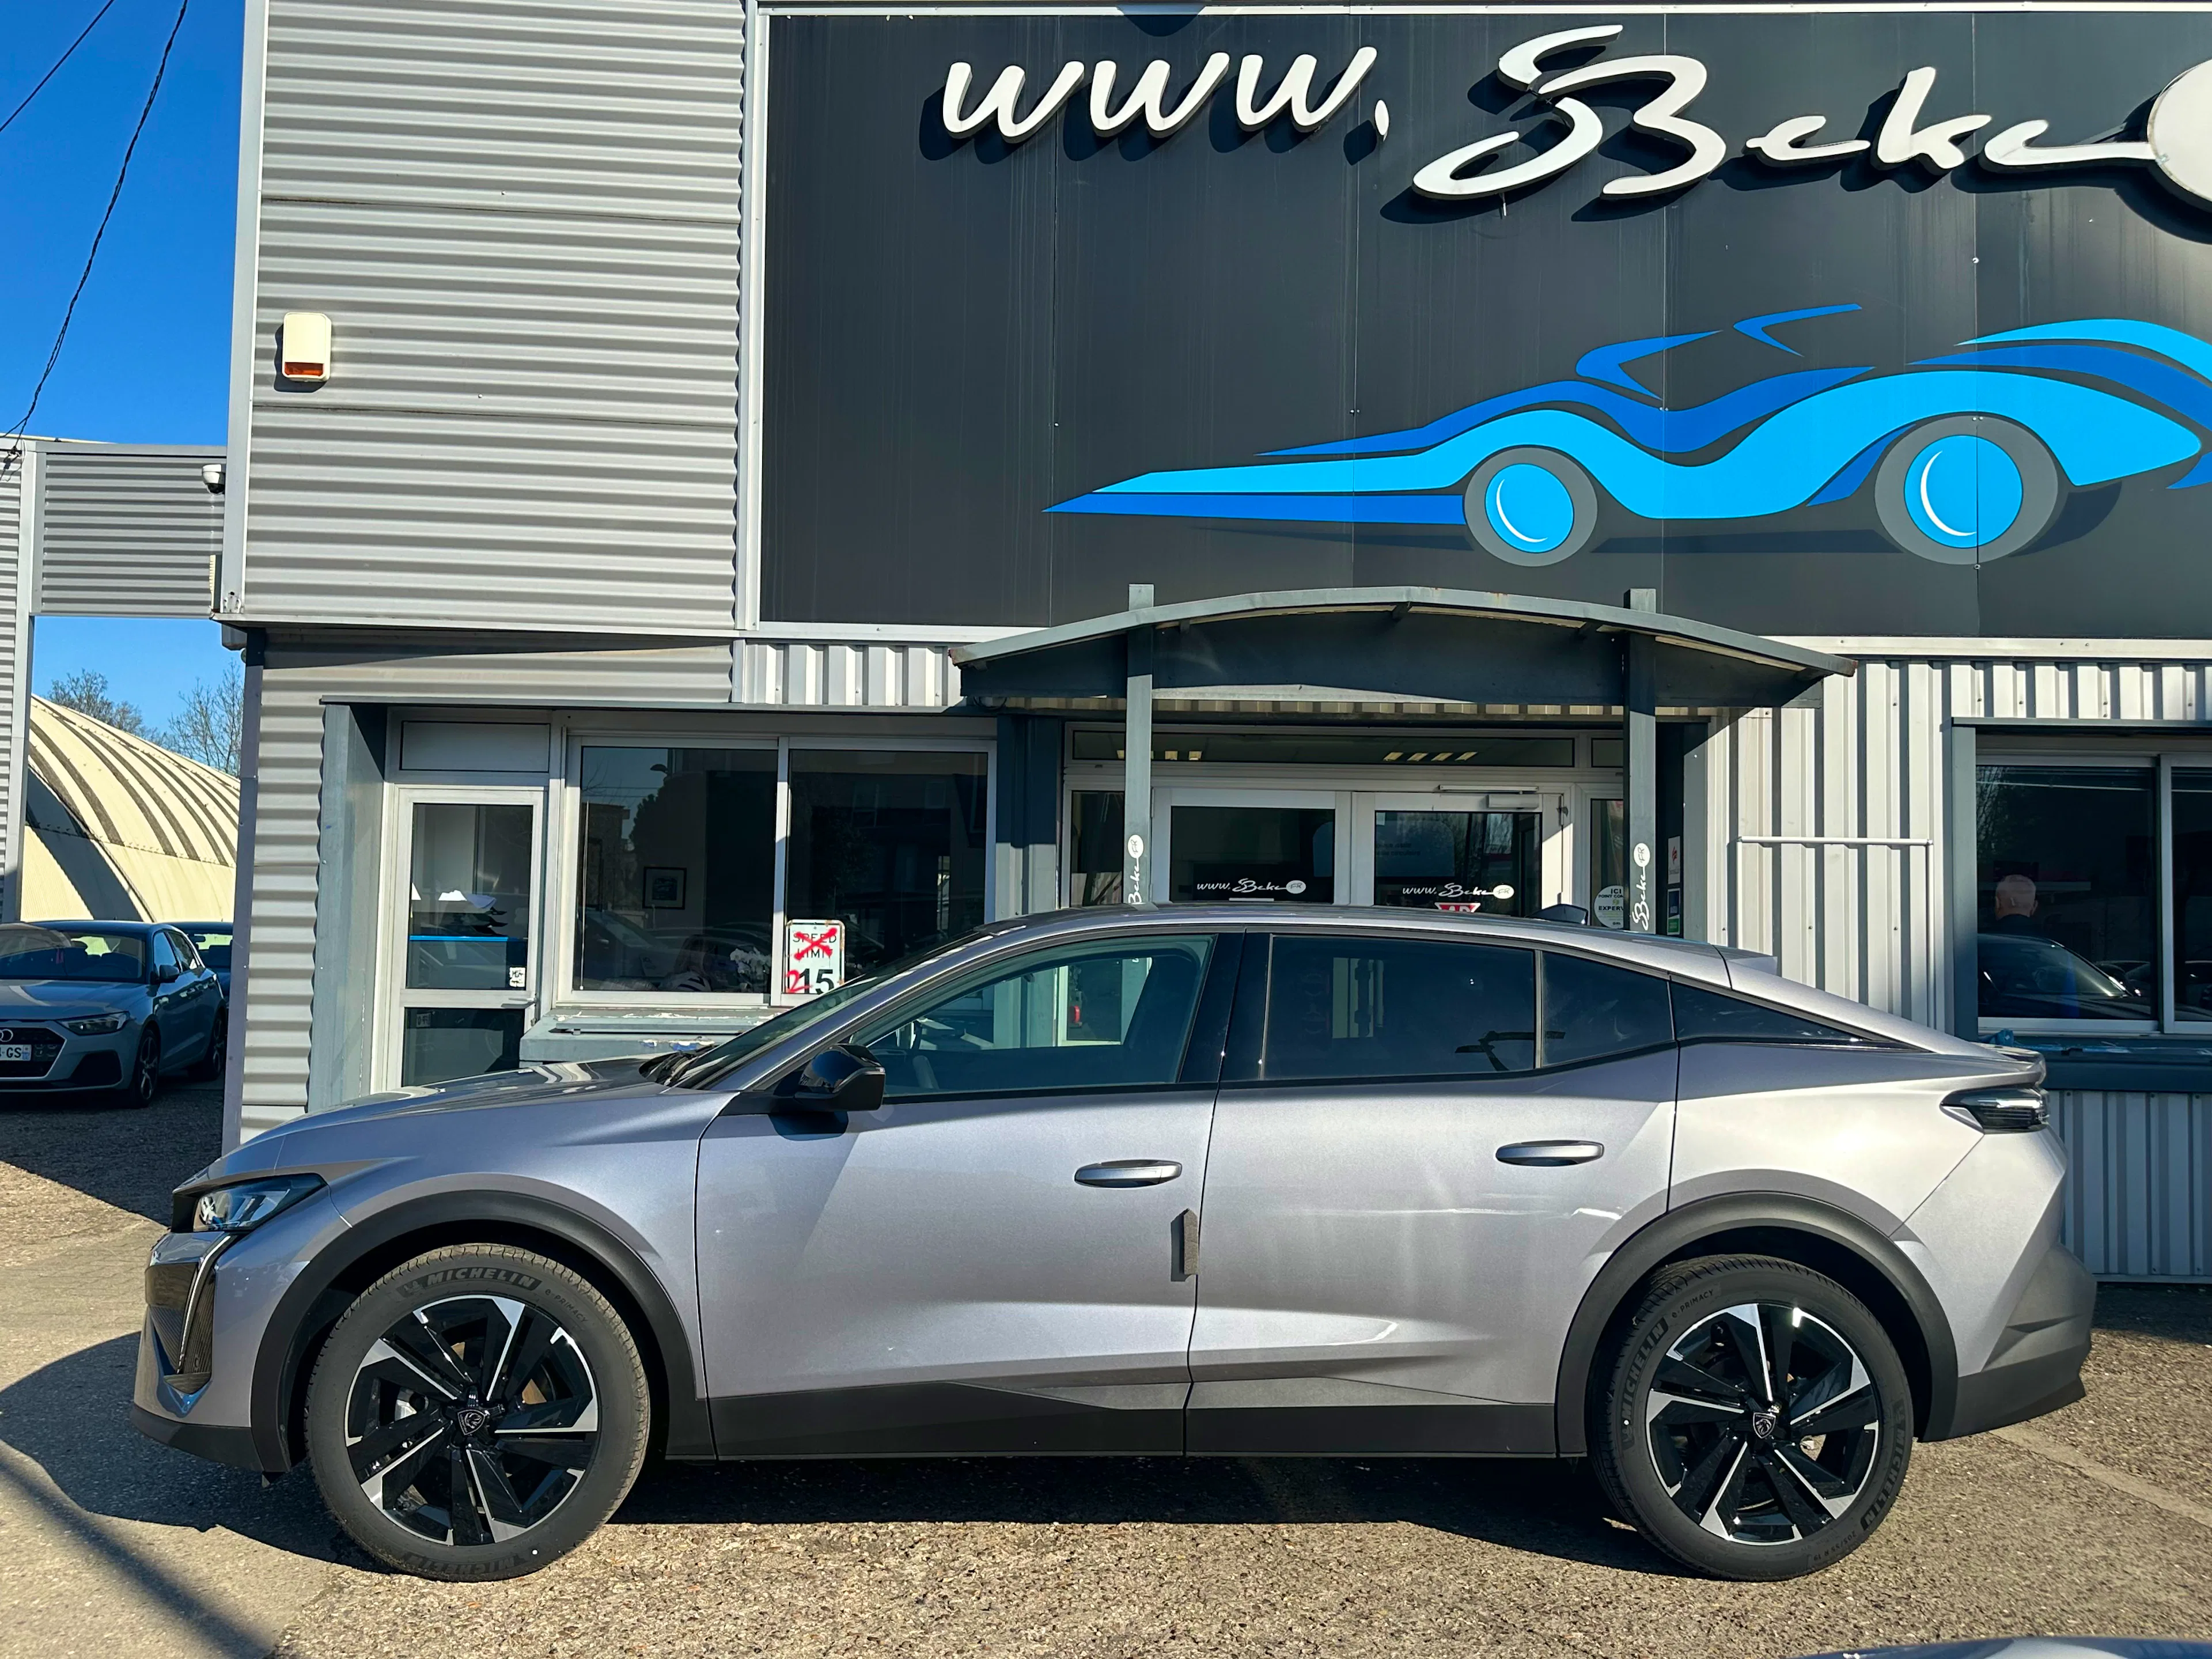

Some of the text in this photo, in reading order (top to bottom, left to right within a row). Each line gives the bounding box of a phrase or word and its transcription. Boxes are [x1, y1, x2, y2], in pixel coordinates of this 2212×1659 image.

[793, 933, 836, 943] SPEED
[797, 948, 833, 959] IMI
[426, 1267, 536, 1288] MICHELIN
[1623, 1321, 1666, 1420] MICHELIN
[1866, 1428, 1906, 1524] MICHELIN
